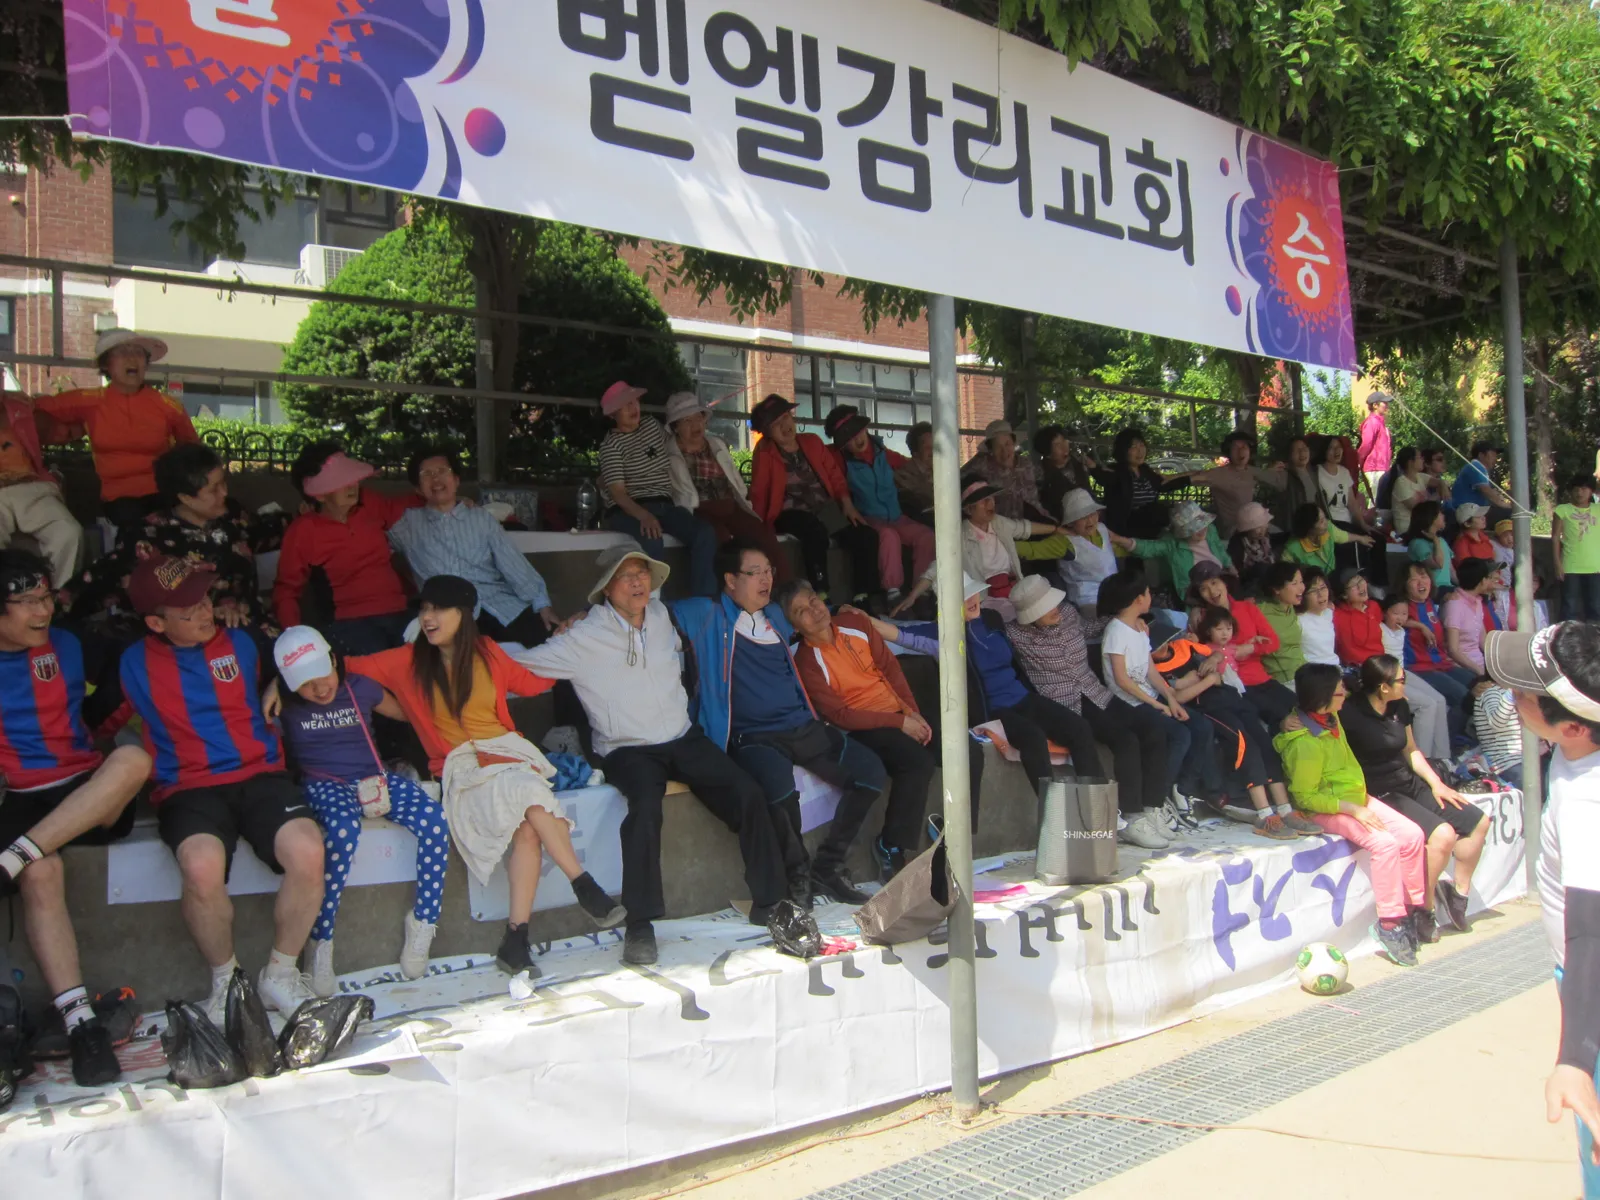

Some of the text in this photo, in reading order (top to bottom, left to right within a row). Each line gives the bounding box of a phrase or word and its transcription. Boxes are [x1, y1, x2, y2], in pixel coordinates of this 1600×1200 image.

[557, 0, 1195, 266] 벧엘감리교회
[1282, 212, 1331, 299] 승
[326, 707, 356, 720] HAPPY
[1063, 830, 1113, 839] SHINSEGAE
